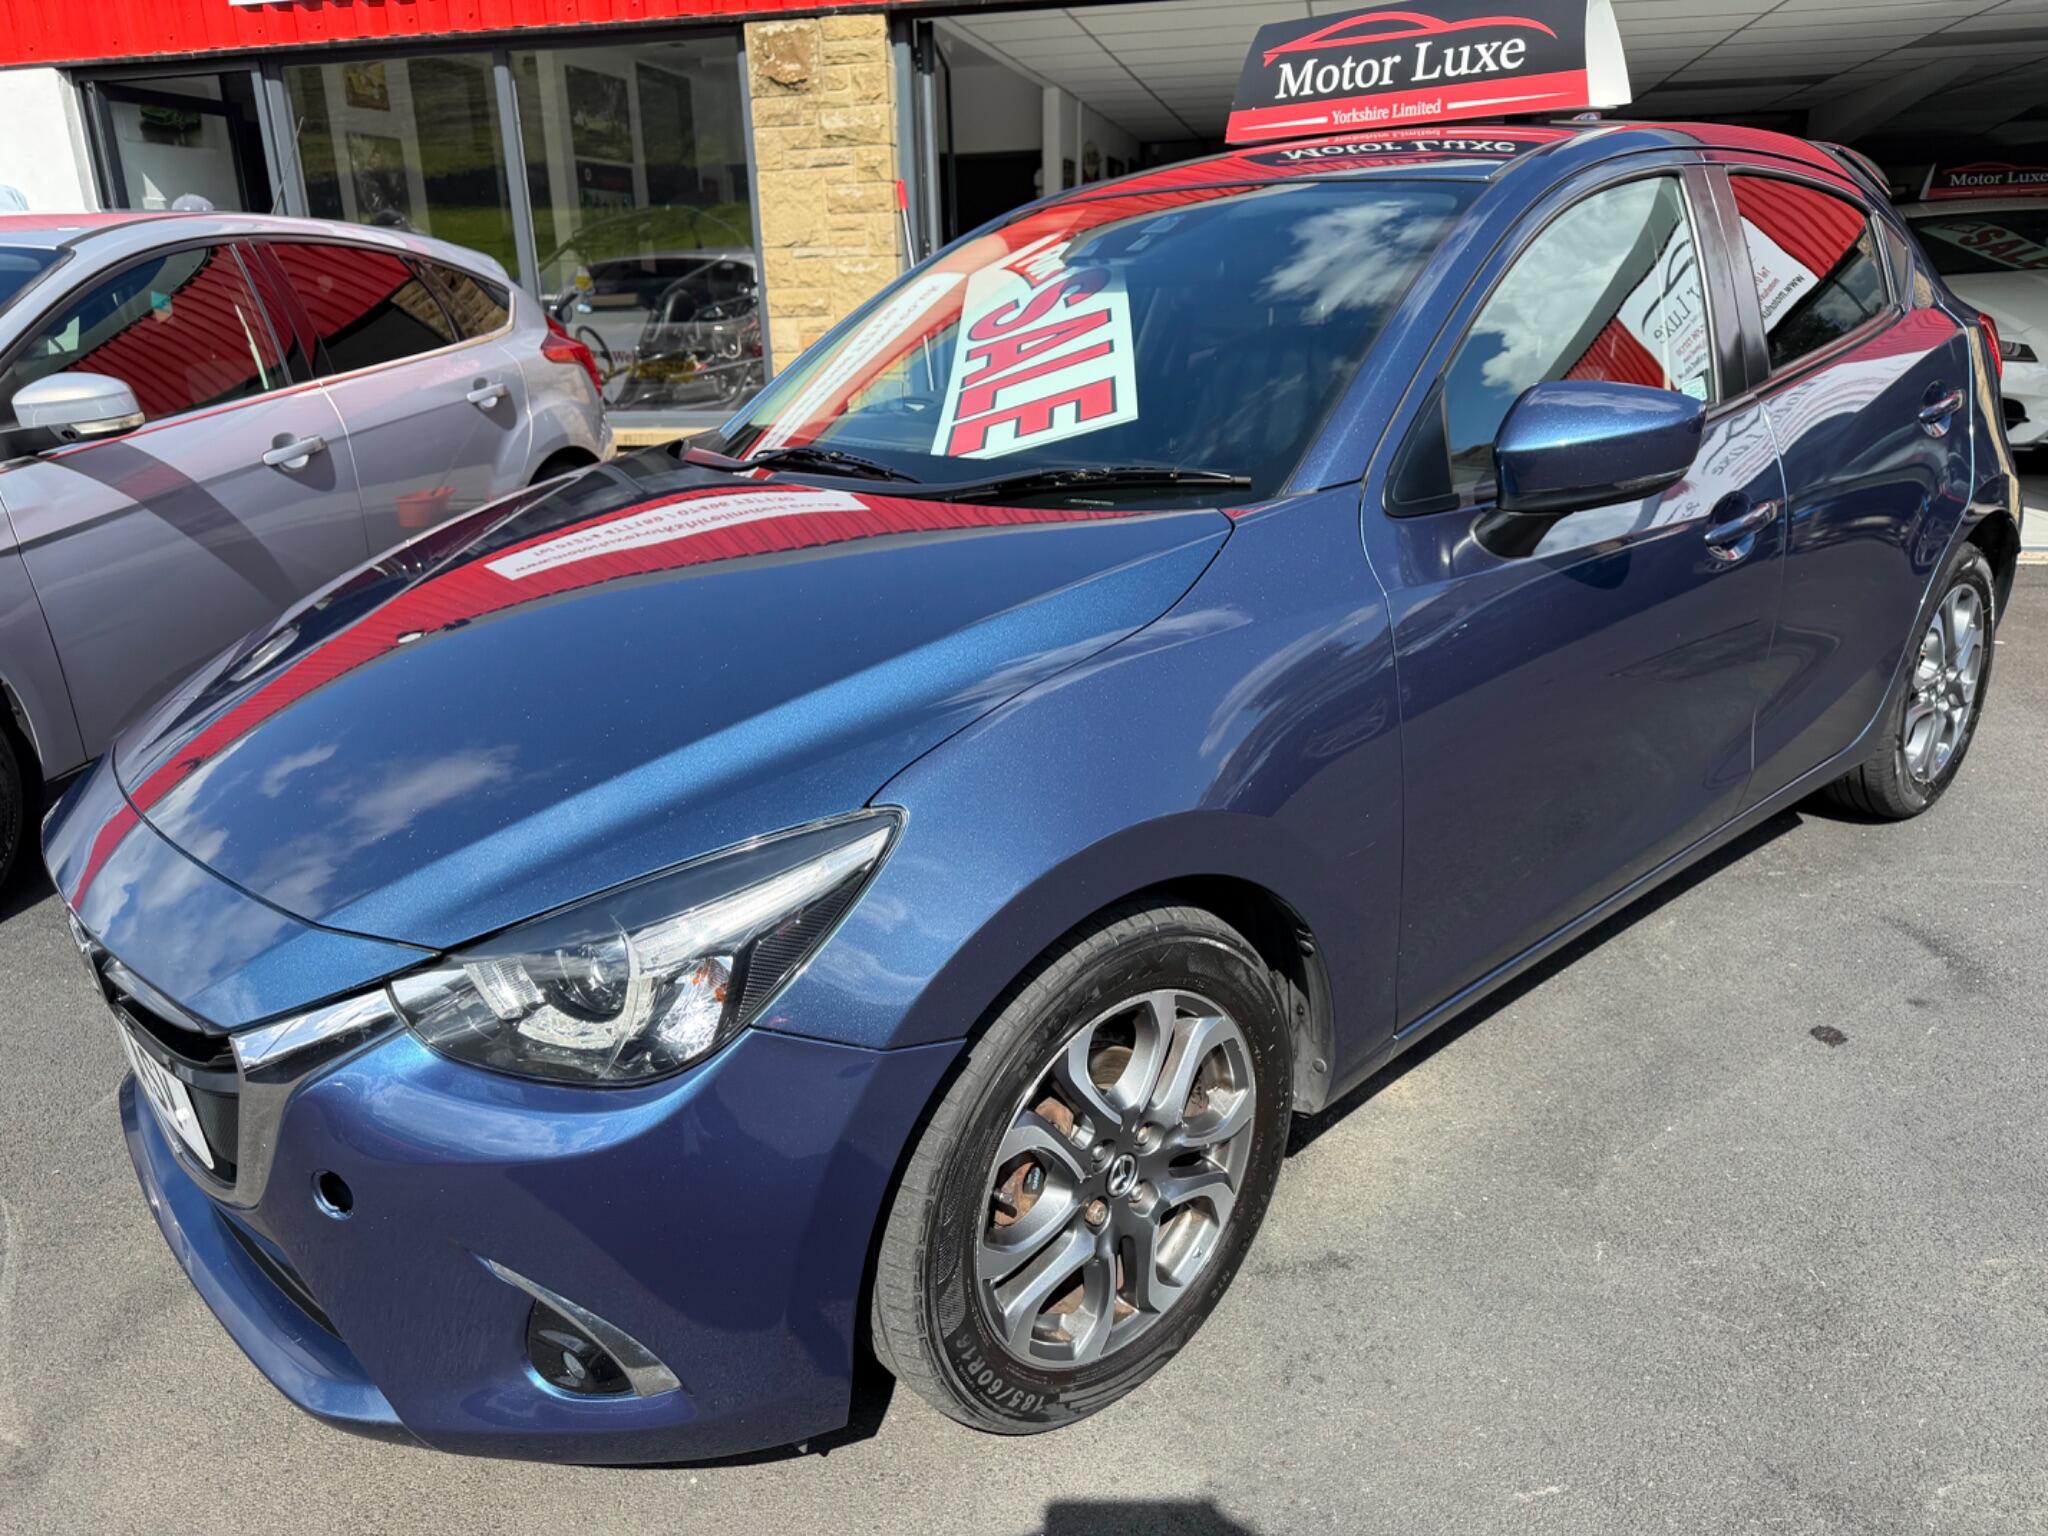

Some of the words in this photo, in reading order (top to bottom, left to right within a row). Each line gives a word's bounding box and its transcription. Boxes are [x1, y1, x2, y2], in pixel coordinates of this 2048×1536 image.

[1274, 54, 1402, 100] Motor
[1411, 37, 1527, 82] Luxe
[1331, 105, 1390, 126] Yorkshire
[1392, 98, 1442, 119] Limited
[1950, 173, 2003, 187] Motor
[2008, 171, 2048, 184] Luxe
[945, 266, 1118, 458] SALE
[956, 1333, 1046, 1414] 185/60R16
